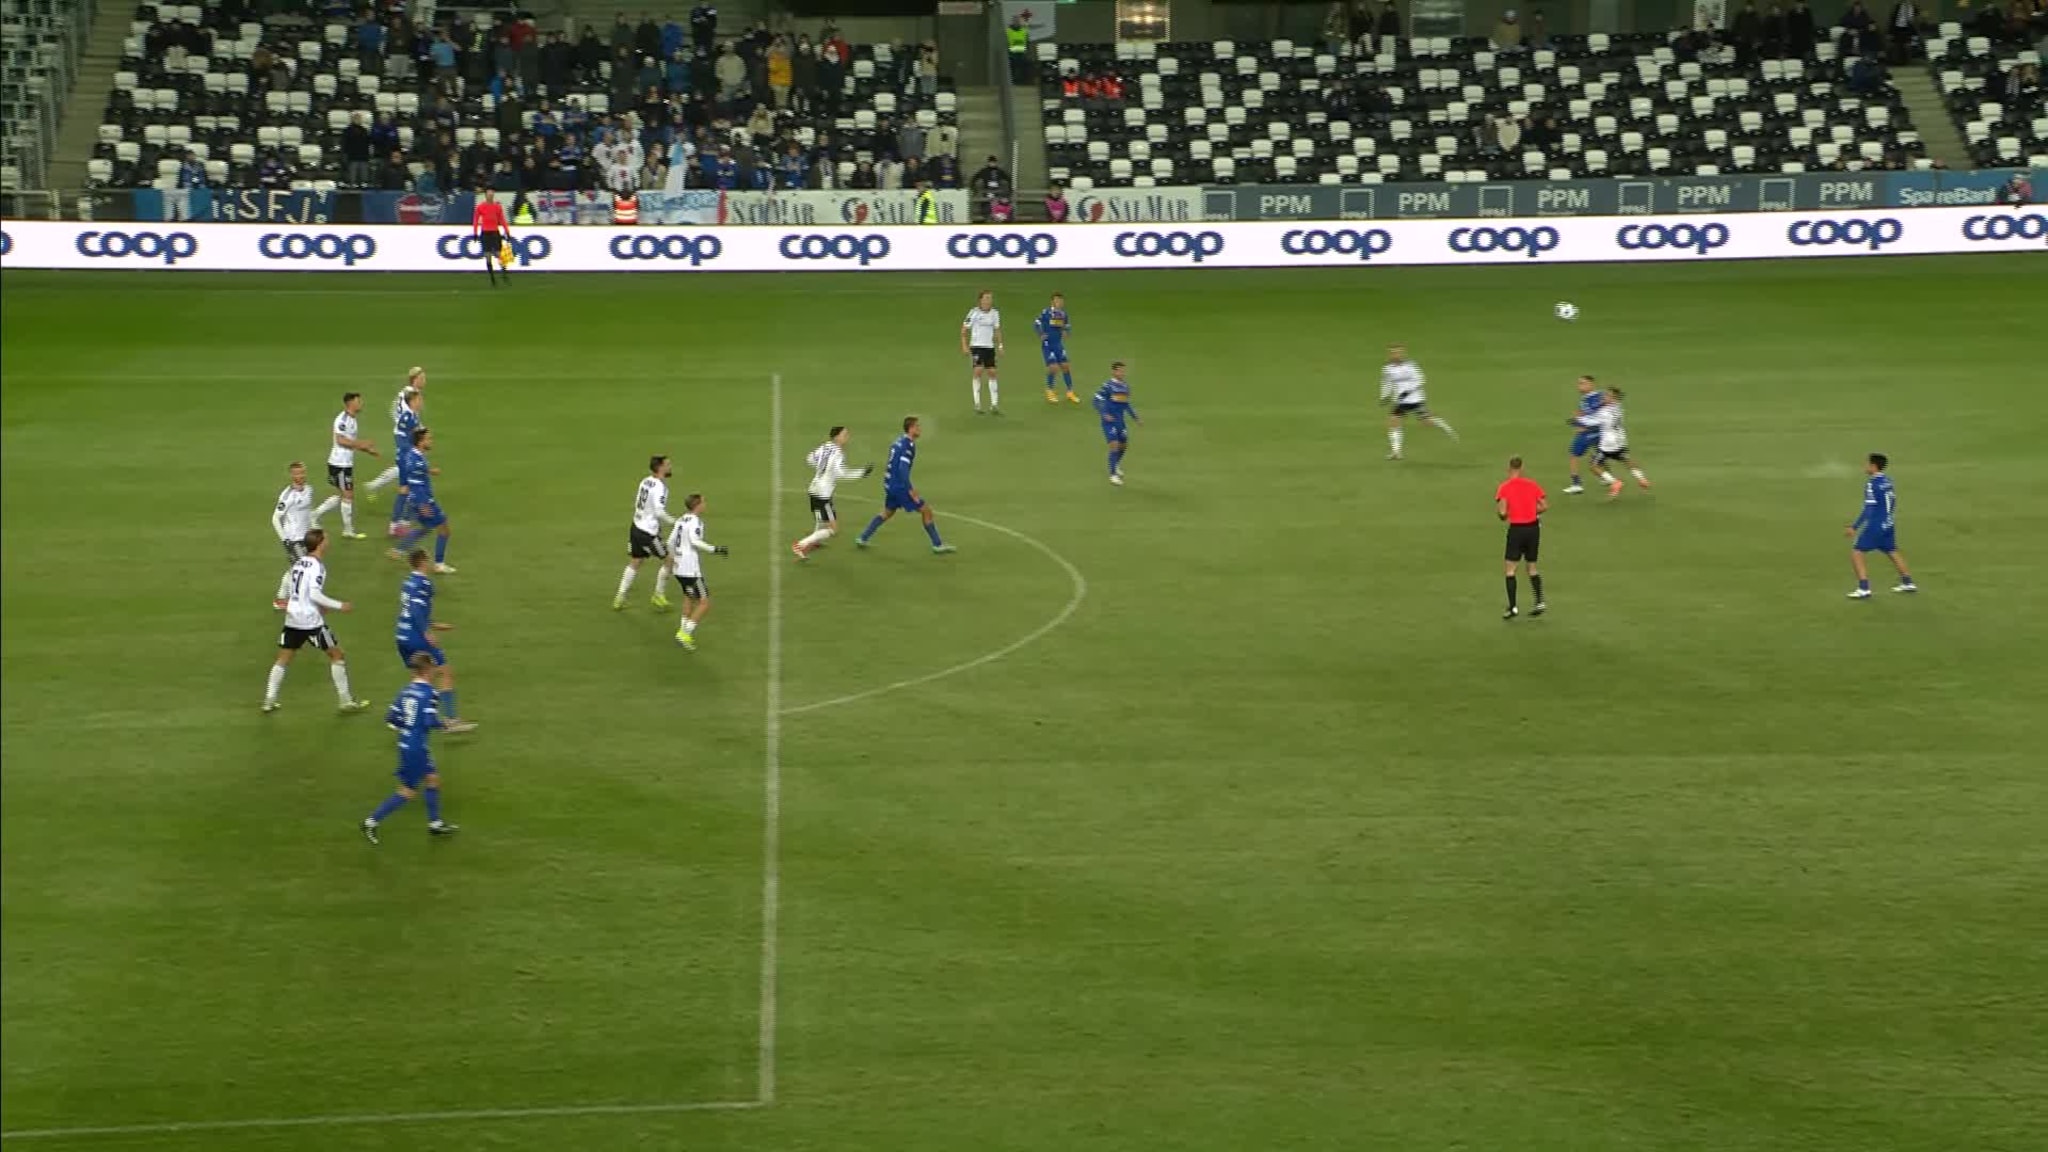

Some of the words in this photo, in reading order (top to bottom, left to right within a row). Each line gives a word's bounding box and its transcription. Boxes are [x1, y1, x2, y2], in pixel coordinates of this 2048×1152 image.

[1260, 194, 1312, 214] PPM
[1398, 192, 1449, 211] PPM
[1537, 189, 1589, 208] PPM
[1677, 185, 1731, 205] PPM
[1819, 181, 1874, 202] PPM
[1281, 228, 1392, 259] coop
[1448, 225, 1560, 257] coop
[1616, 222, 1731, 255] coop
[1787, 218, 1904, 251] coop
[1962, 213, 2048, 247] coo
[75, 231, 199, 265] coop
[258, 232, 377, 266] coop
[435, 234, 553, 267] cop
[609, 234, 722, 266] coop
[779, 233, 890, 266] coop
[947, 232, 1058, 265] coop
[1113, 231, 1224, 262] coop
